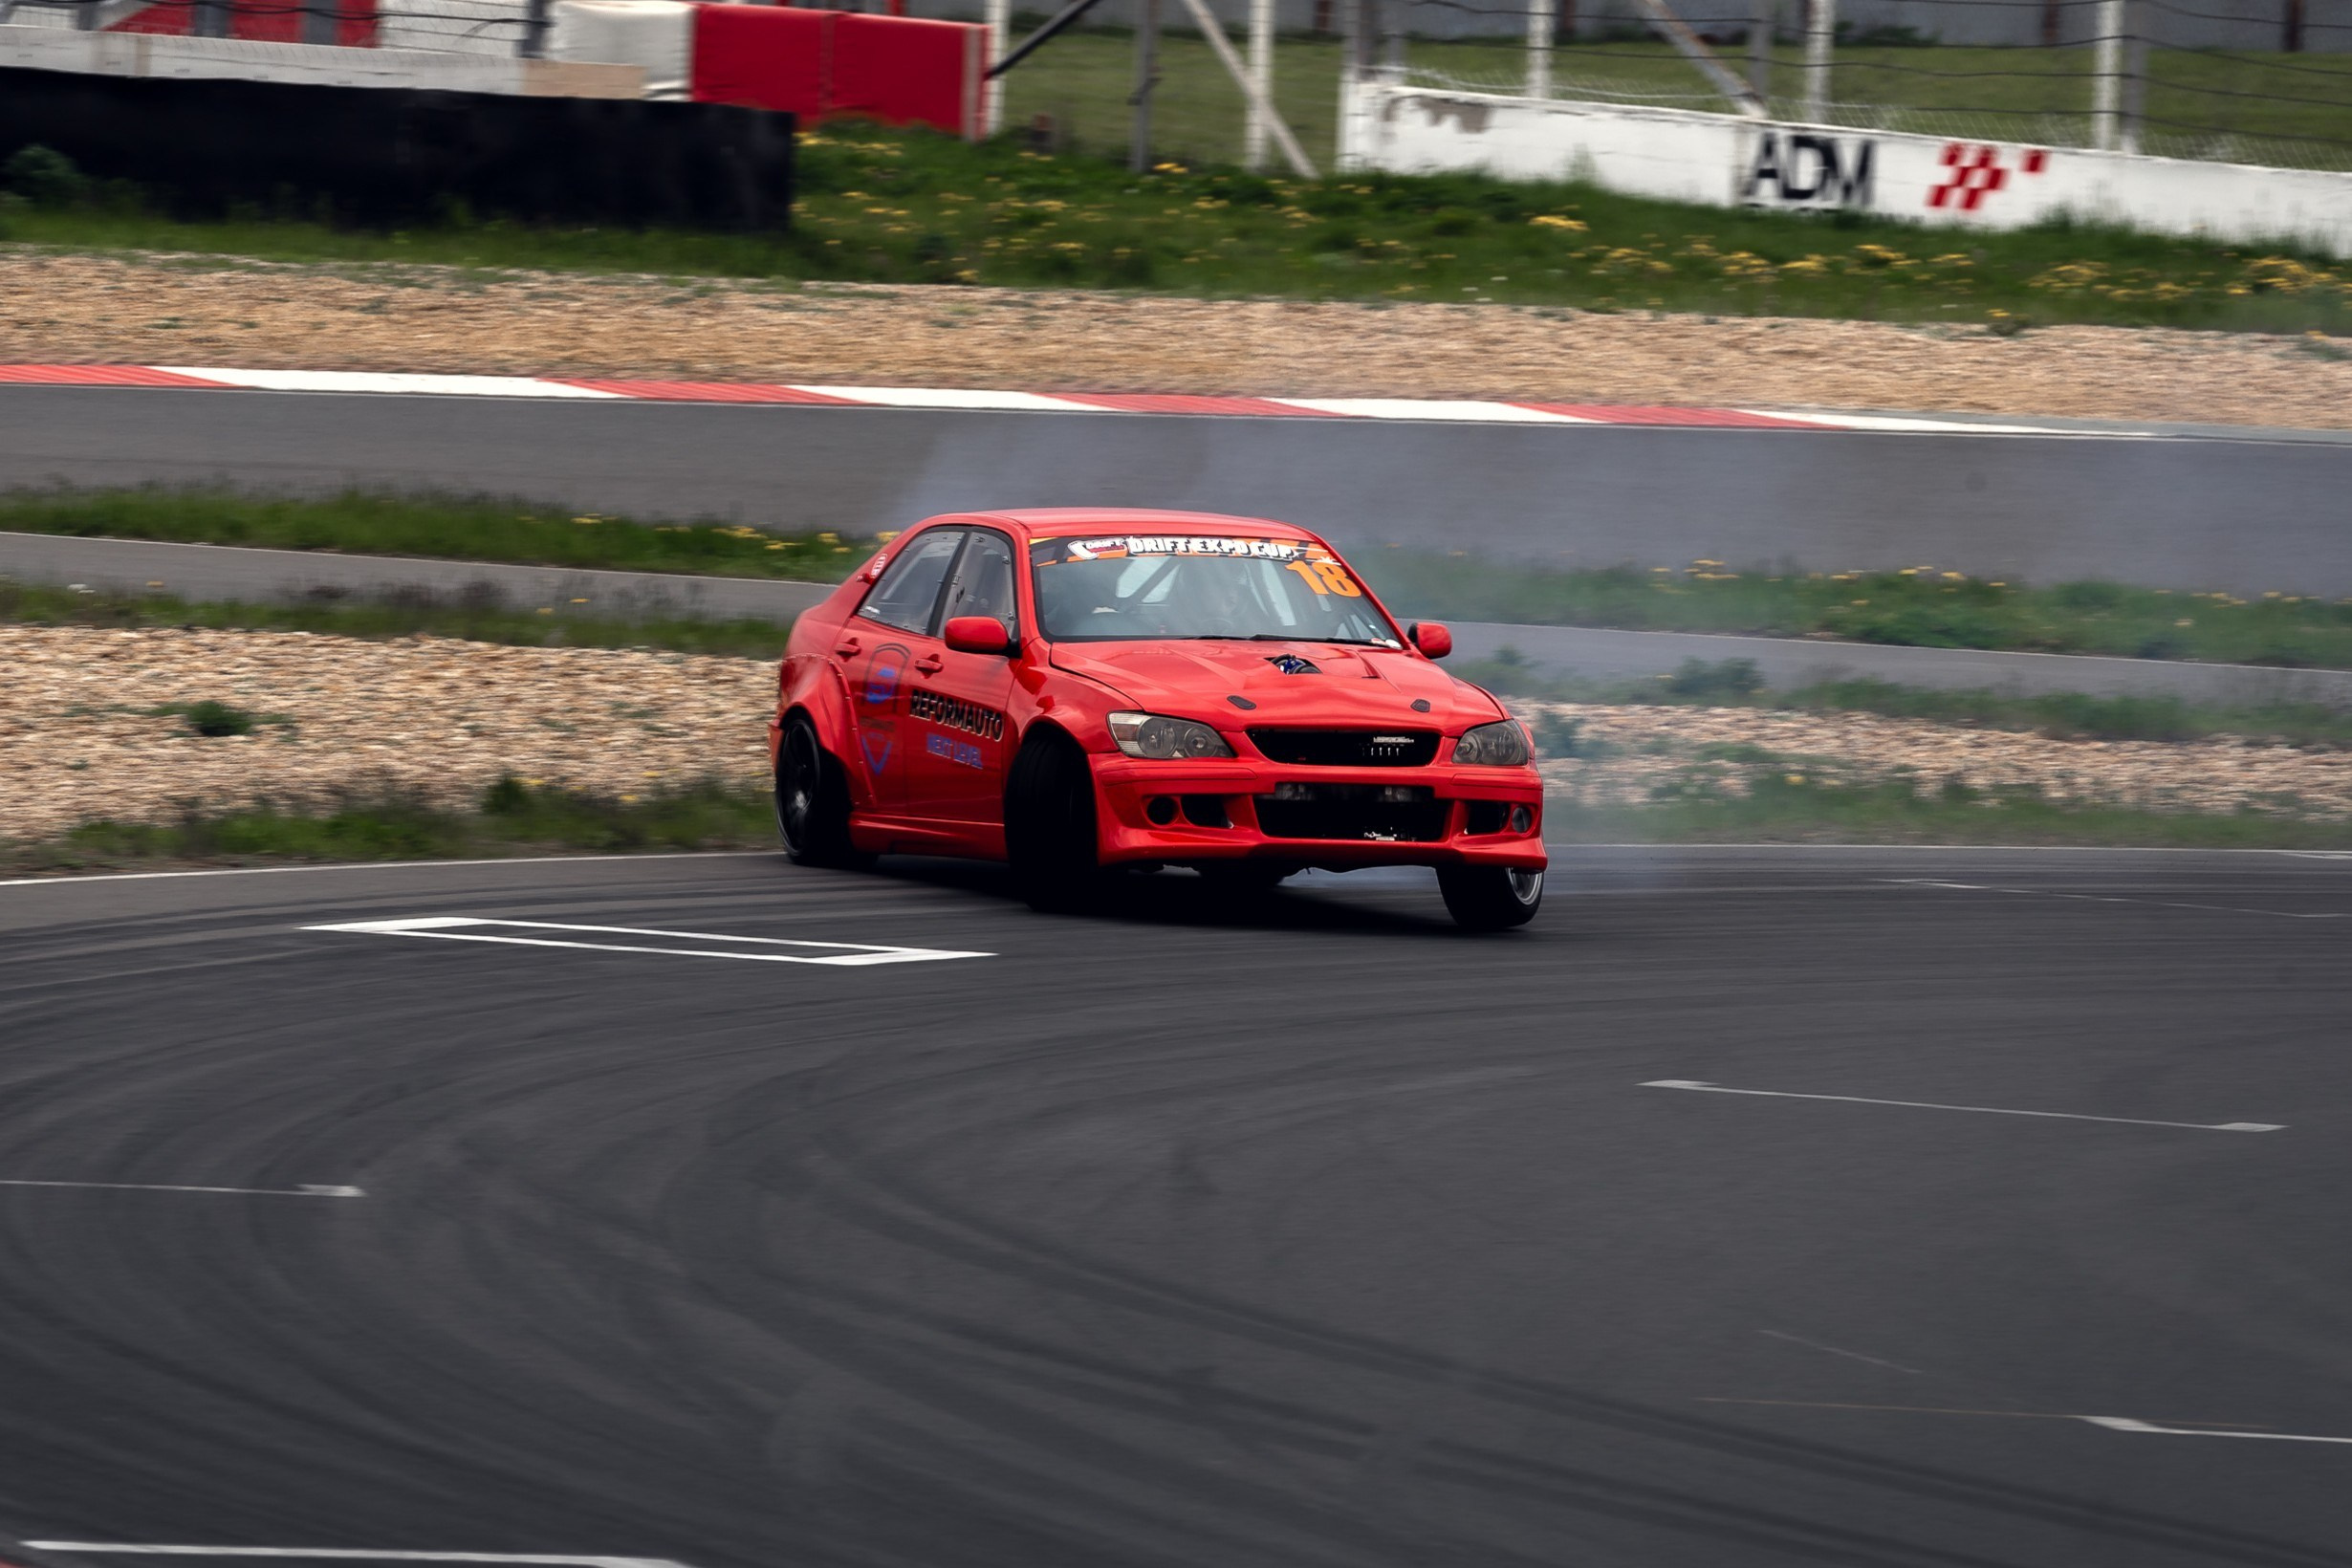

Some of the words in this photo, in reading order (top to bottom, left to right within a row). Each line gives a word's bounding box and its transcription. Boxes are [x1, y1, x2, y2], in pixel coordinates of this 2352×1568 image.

[1744, 133, 1875, 205] ADM
[1127, 536, 1190, 555] DRIFT
[1190, 537, 1251, 556] EXPO
[1251, 541, 1294, 560] CUP
[1285, 560, 1361, 598] 18
[908, 688, 1004, 742] REFORMAUTO
